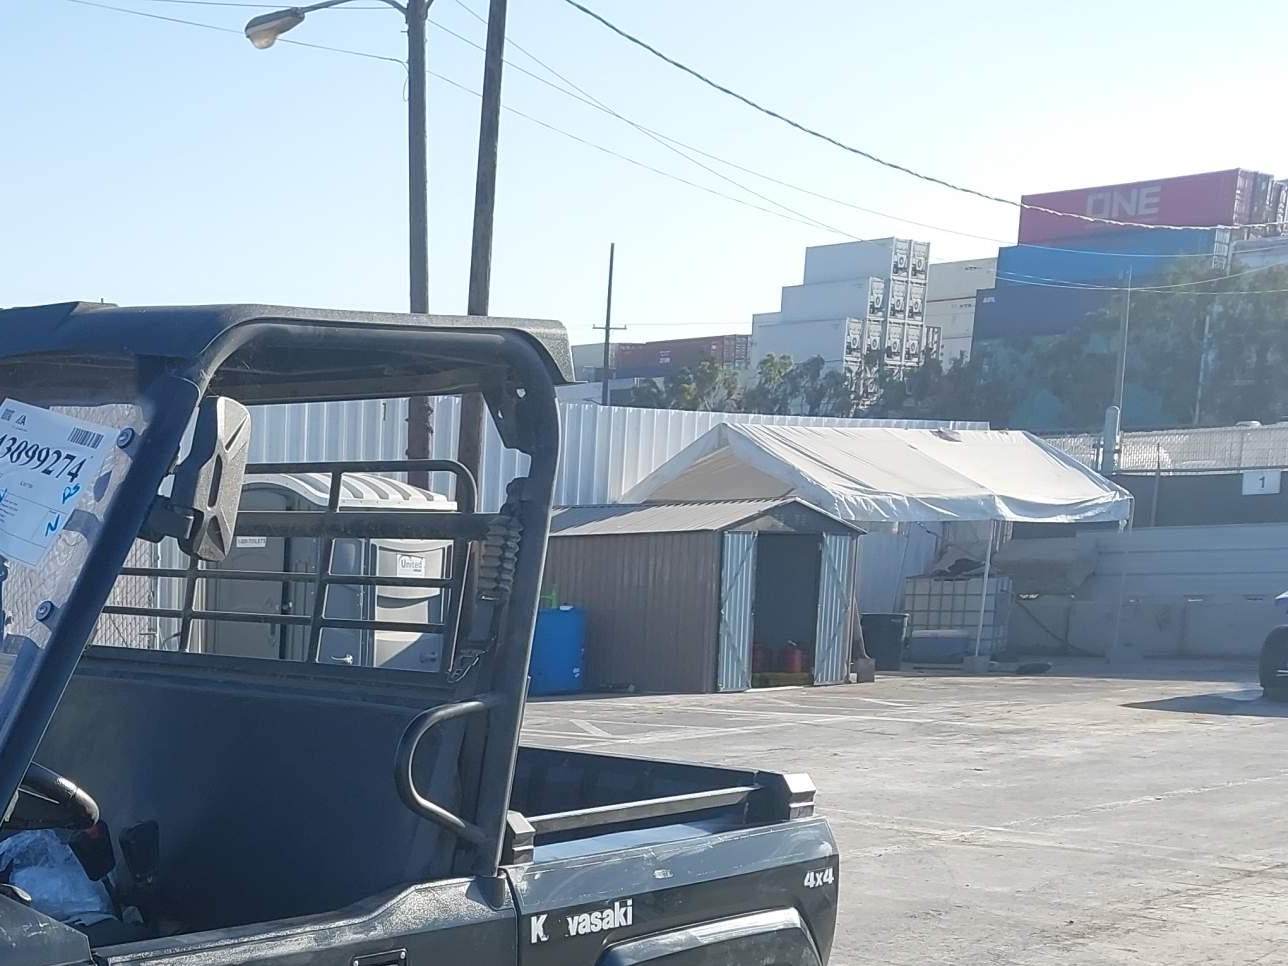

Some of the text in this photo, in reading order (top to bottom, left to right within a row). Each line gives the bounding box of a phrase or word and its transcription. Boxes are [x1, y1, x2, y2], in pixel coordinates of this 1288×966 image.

[1086, 184, 1161, 219] ONE
[1259, 476, 1265, 489] 1
[804, 867, 834, 888] 4x4
